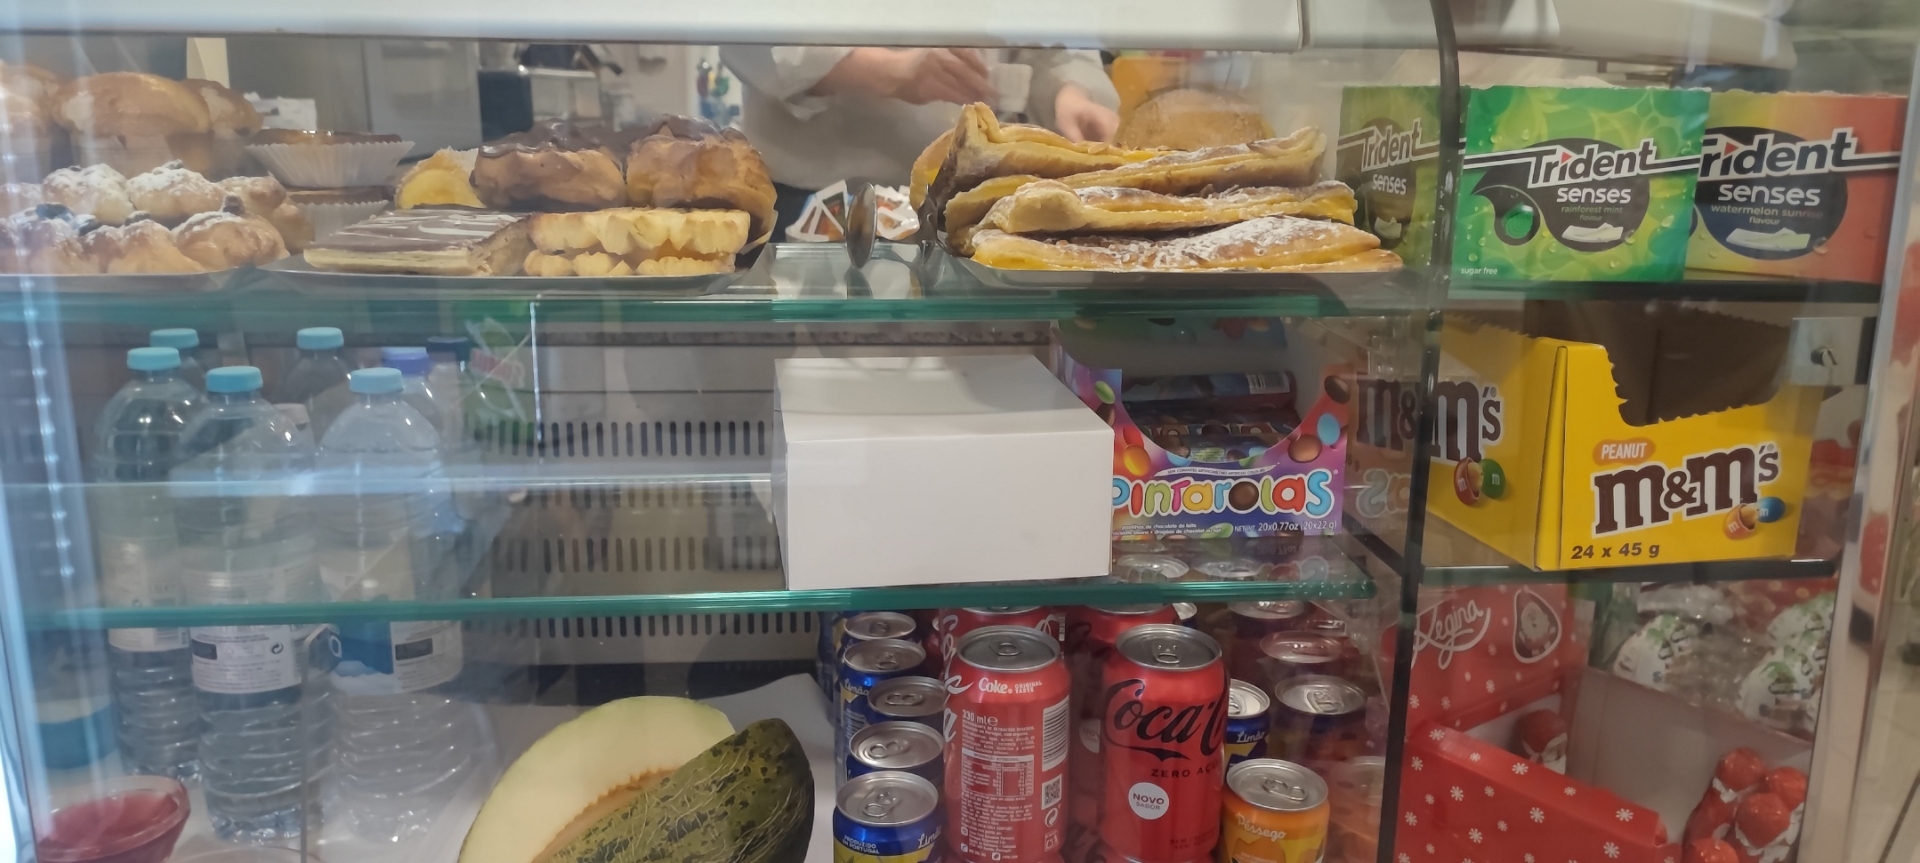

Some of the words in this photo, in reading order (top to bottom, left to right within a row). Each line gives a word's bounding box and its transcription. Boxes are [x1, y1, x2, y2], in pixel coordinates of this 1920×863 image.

[1361, 117, 1422, 172] Trident
[1528, 138, 1657, 188] Trident
[1372, 173, 1407, 195] senses
[1556, 187, 1632, 204] senses
[1717, 184, 1821, 206] senses
[1561, 205, 1602, 214] rainforest
[1603, 206, 1623, 214] mint
[1711, 205, 1779, 216] watermelon
[1749, 217, 1780, 226] flavour
[1460, 267, 1482, 276] sugar
[1483, 266, 1498, 275] free
[1601, 442, 1648, 460] PEANUT
[1593, 444, 1780, 535] m&m's
[1258, 521, 1299, 532] 20x0.77oz
[1571, 545, 1594, 559] 24
[1601, 549, 1612, 558] x
[1618, 542, 1642, 556] 45
[1648, 544, 1660, 558] g
[979, 677, 1008, 694] Coke
[1151, 768, 1190, 778] ZERO
[1132, 793, 1165, 805] NOVO
[1135, 801, 1161, 811] SABOR
[1235, 812, 1287, 842] Pêssego
